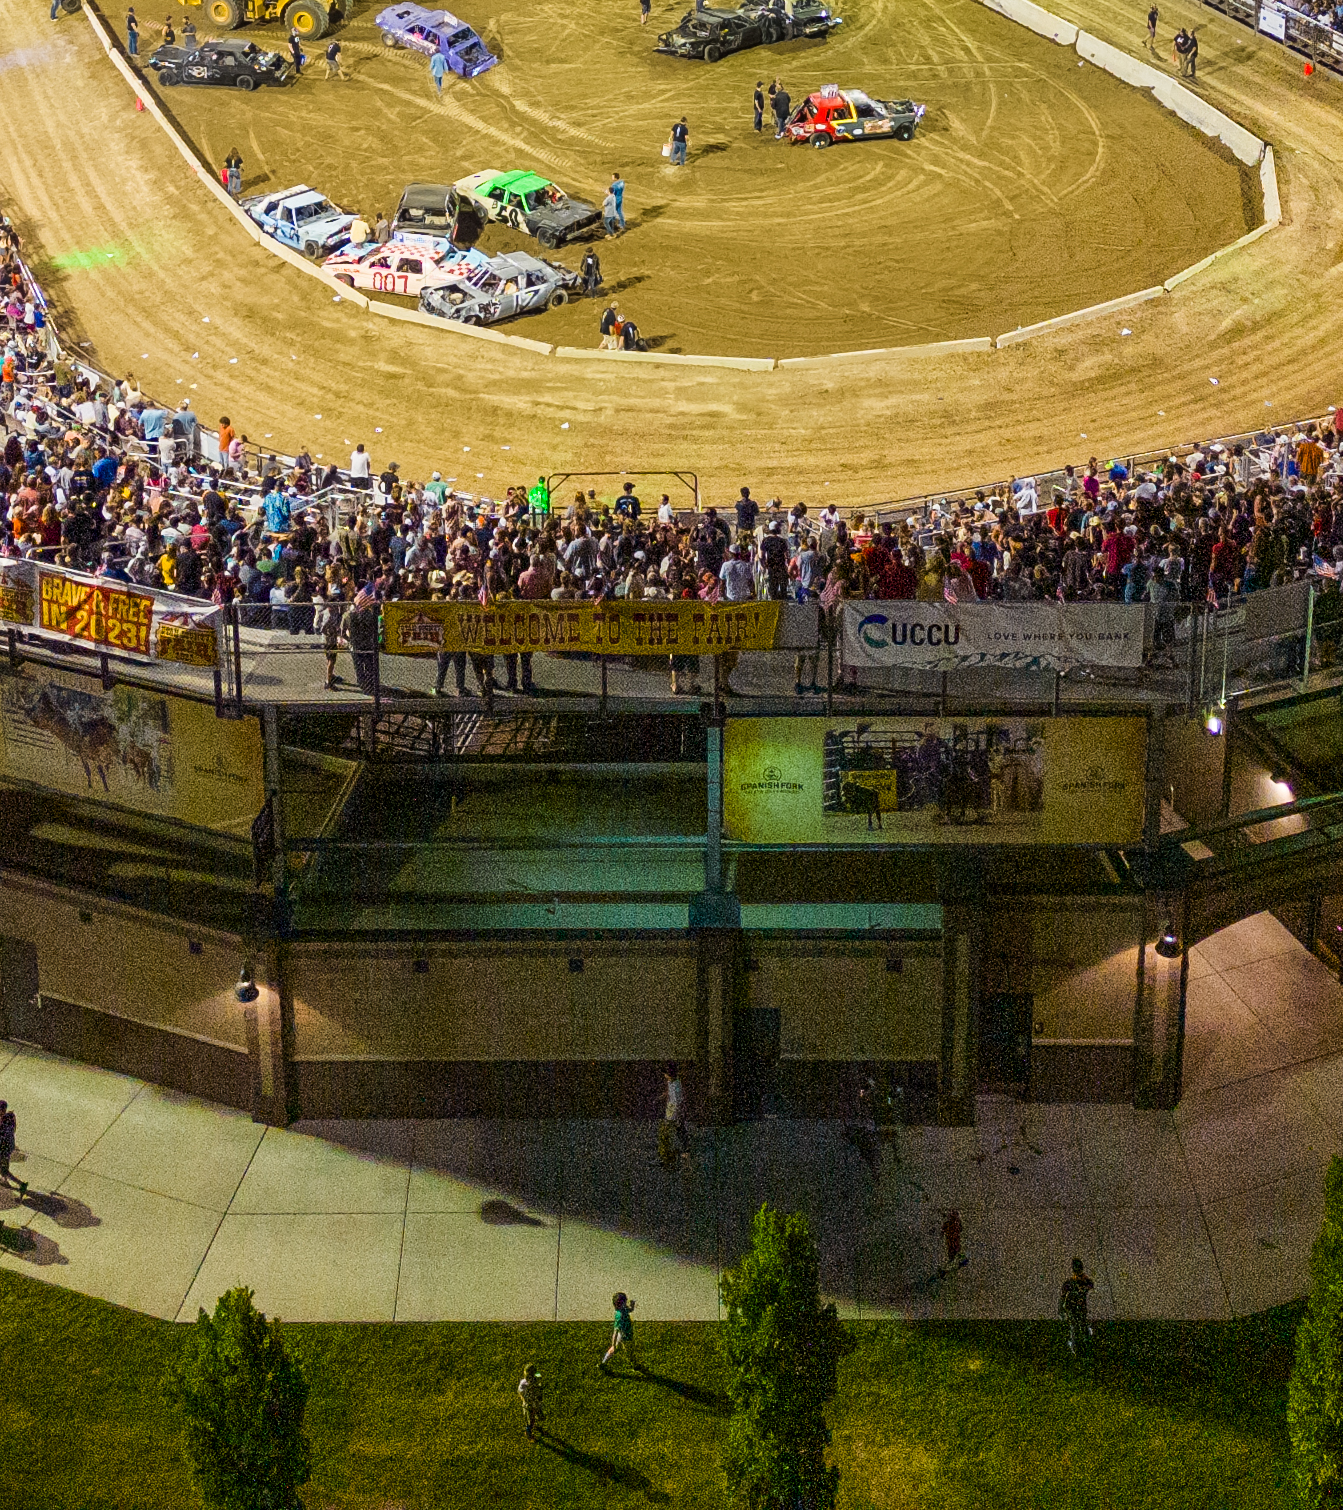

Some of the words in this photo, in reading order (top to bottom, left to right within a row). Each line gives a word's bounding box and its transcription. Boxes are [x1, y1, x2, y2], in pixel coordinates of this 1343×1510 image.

[373, 271, 409, 294] 007
[514, 289, 541, 314] 17
[42, 576, 91, 607] BRAVE
[108, 593, 151, 624] FREE
[42, 601, 68, 631] IN
[74, 609, 148, 651] 2023!
[460, 611, 581, 646] WELCOME
[593, 612, 620, 645] TO
[633, 613, 679, 645] THE
[691, 612, 760, 645] FAIR!
[891, 622, 960, 646] UCCU
[987, 632, 1017, 641] LOVE
[1023, 632, 1064, 641] WHERE
[1068, 632, 1093, 641] YOU
[1097, 632, 1131, 641] BANK
